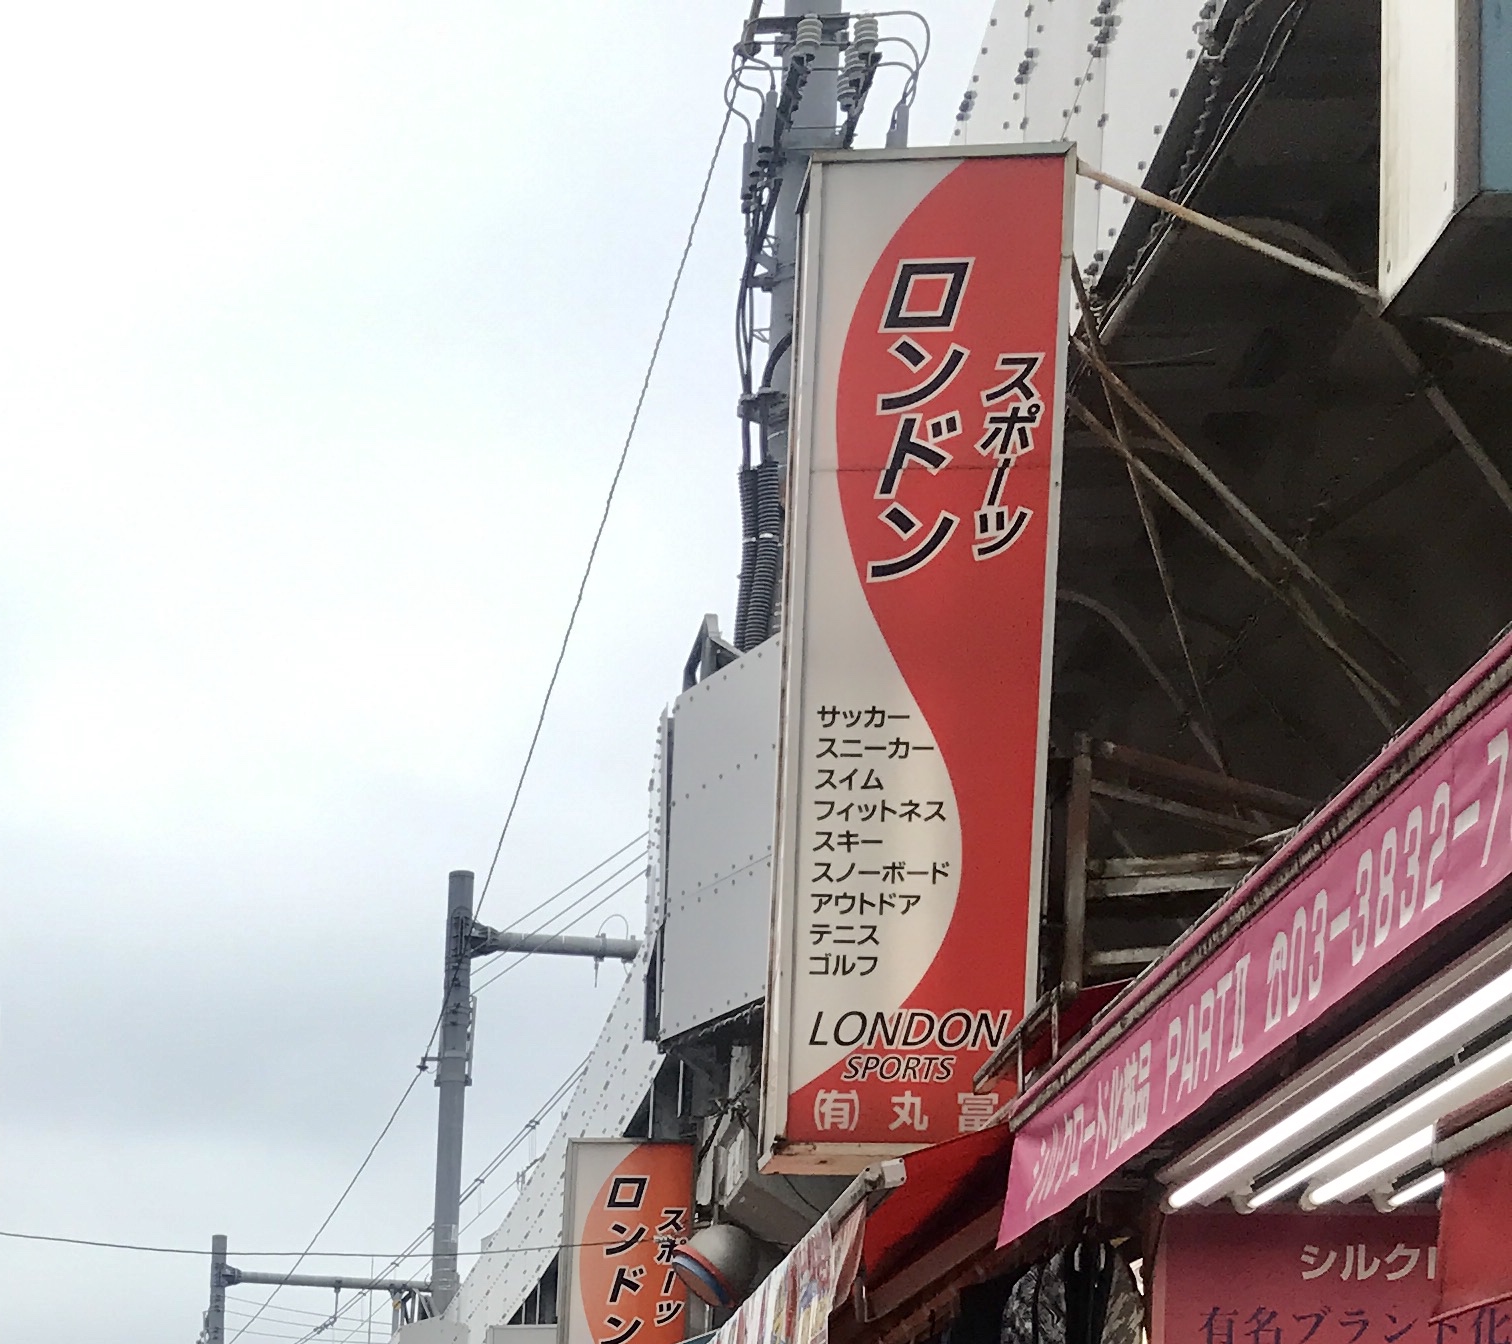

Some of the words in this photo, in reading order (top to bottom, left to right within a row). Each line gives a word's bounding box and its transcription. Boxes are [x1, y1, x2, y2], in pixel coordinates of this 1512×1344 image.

[866, 257, 976, 584] ロンドン
[972, 352, 1046, 562] スポーツ
[817, 705, 910, 728] サッカー
[815, 738, 934, 760] スニーカー
[815, 769, 884, 791] スイム
[814, 799, 946, 822] フィットネス
[813, 830, 883, 853] スキー
[812, 861, 949, 885] スノーボード
[811, 893, 921, 915] アウトドア
[809, 924, 880, 946] テニス
[809, 954, 879, 977] ゴルフ
[808, 1007, 1013, 1051] LONDON
[841, 1055, 957, 1084] SPORTS
[654, 1208, 688, 1326] スポーツ
